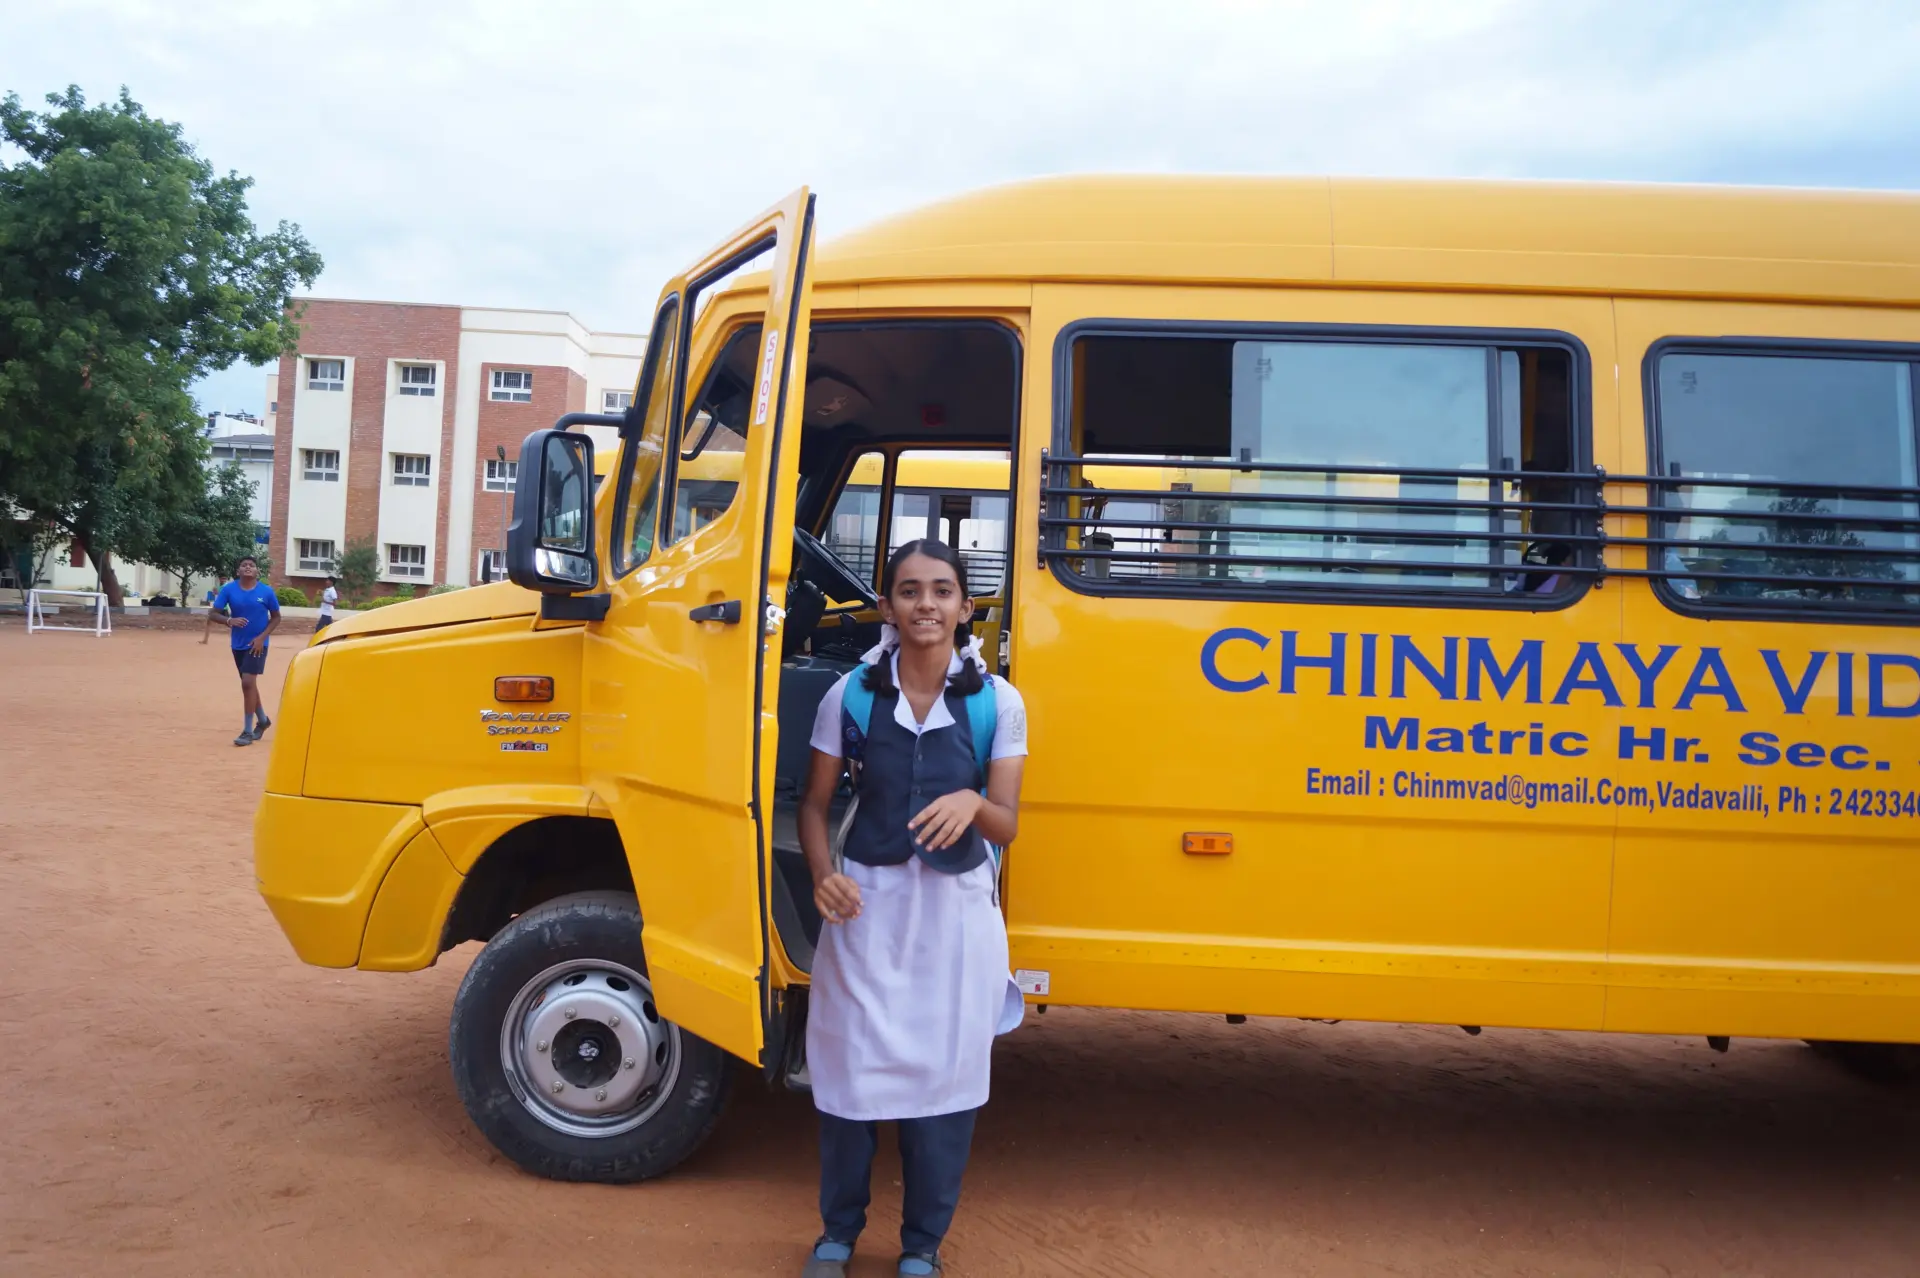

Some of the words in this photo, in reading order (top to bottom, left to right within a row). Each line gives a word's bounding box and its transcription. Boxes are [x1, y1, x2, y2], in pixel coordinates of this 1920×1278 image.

[759, 335, 776, 419] STOP
[1201, 628, 1748, 714] CHINMAYA
[1759, 649, 1920, 718] VID
[1365, 715, 1588, 757] Matric
[1619, 726, 1709, 763] Hr.
[1738, 732, 1891, 771] Sec.
[1829, 789, 1920, 819] 242334
